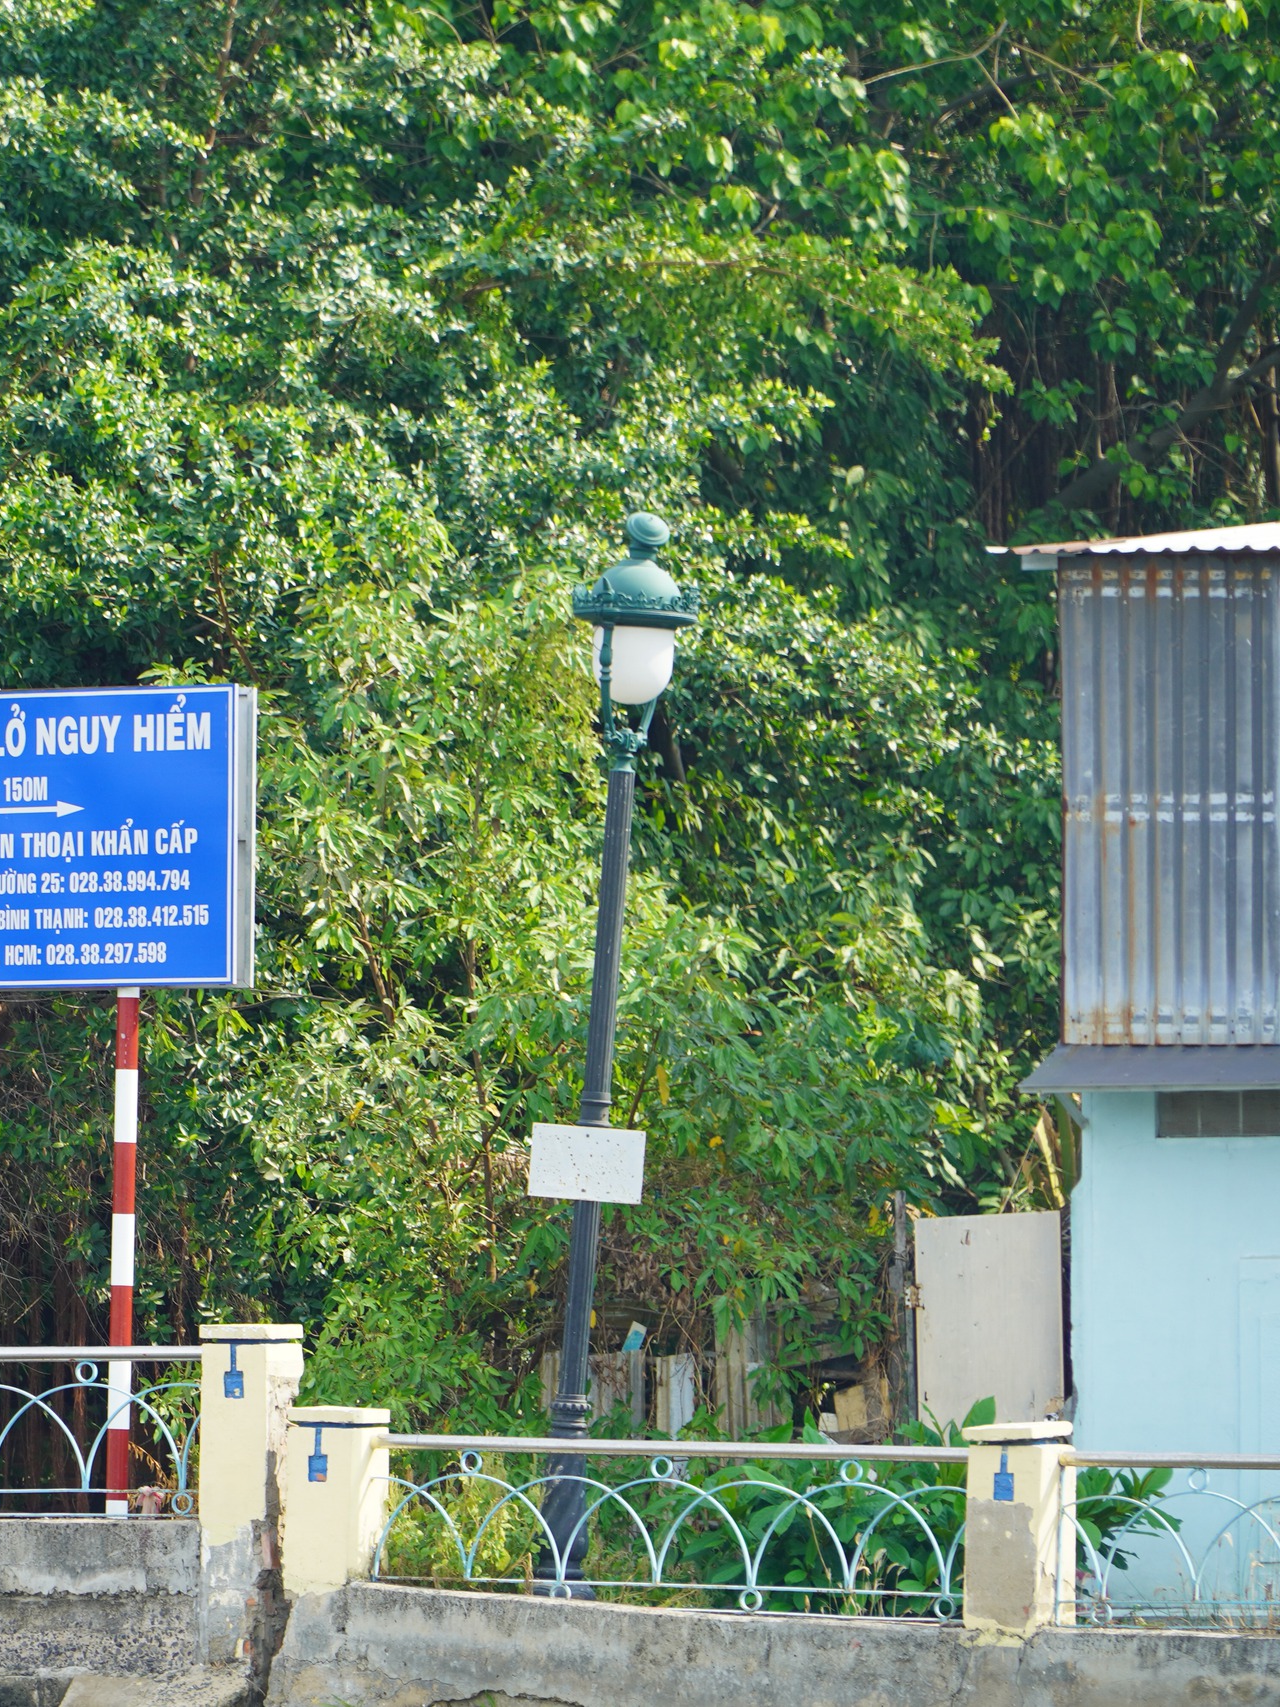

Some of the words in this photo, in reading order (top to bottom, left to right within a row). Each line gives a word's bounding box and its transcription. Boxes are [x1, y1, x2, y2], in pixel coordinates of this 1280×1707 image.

[36, 715, 121, 755] NGUY
[133, 694, 210, 752] HIỂM
[3, 776, 47, 801] 150M
[21, 831, 83, 862] THOẠI
[91, 818, 148, 856] KHẨN
[155, 820, 197, 854] CẤP
[41, 873, 64, 893] 25:
[69, 870, 190, 893] 028.38.994.794
[34, 908, 88, 934] THẠNH:
[94, 905, 208, 928] 028.38.412.515
[5, 945, 41, 965] HCM:
[46, 942, 166, 965] 028.38.297.598
